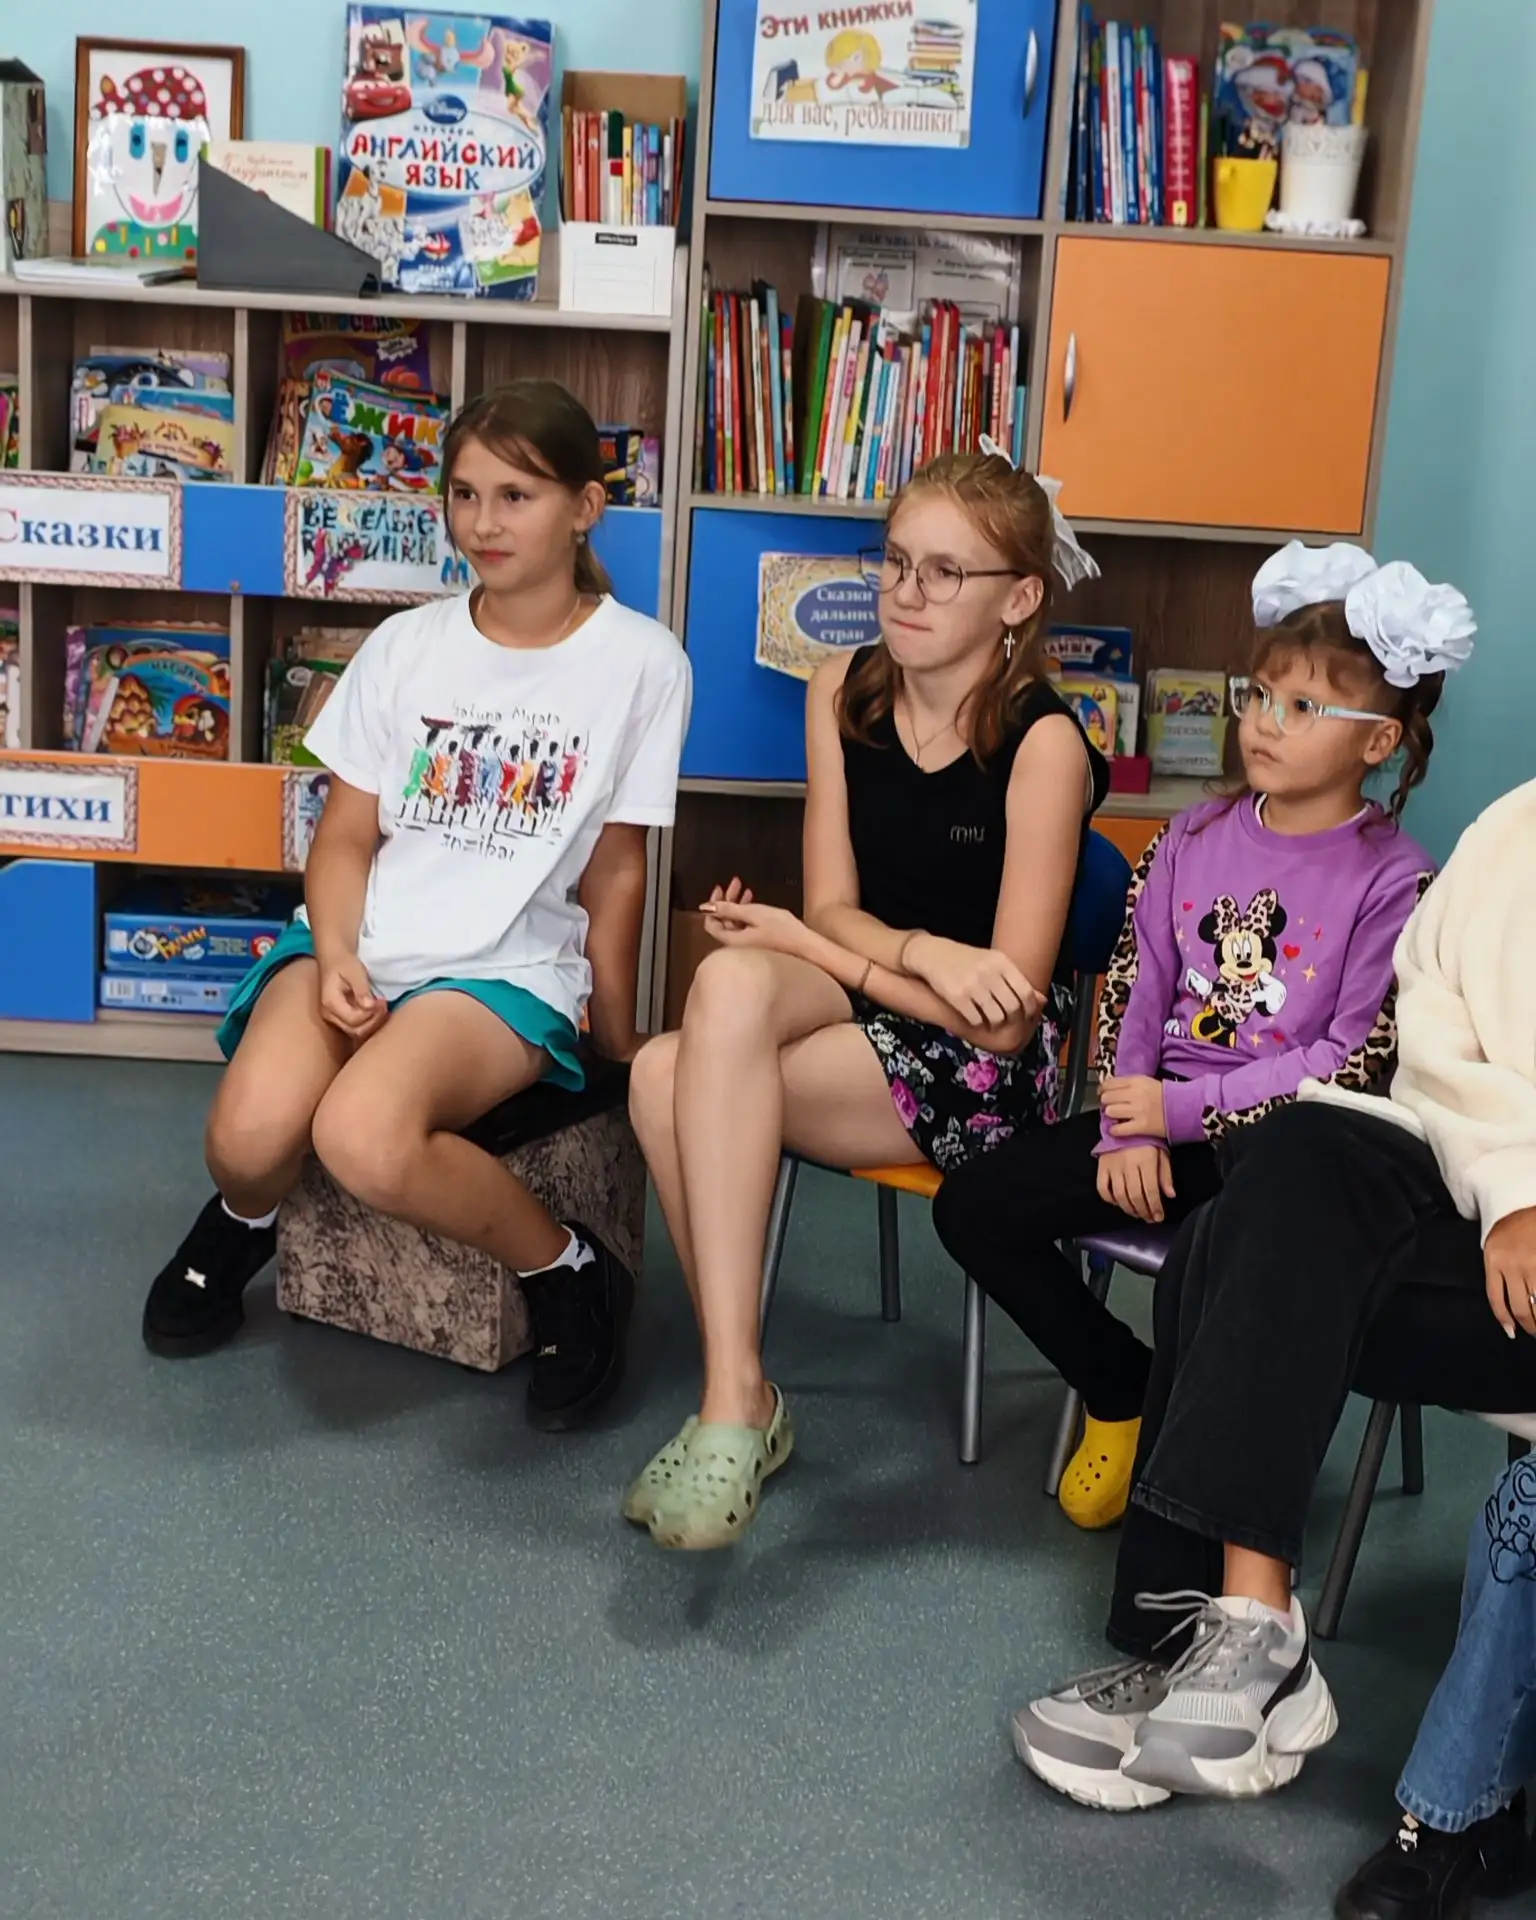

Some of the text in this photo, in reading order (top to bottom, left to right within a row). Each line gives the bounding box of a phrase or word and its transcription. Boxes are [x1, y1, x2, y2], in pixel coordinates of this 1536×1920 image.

[761, 0, 914, 39] Эти книжки
[761, 103, 795, 128] для
[802, 103, 838, 131] вас,
[351, 133, 536, 171] АНГЛИЙСКИЙ
[406, 163, 480, 190] ЯЗЫК
[0, 508, 163, 552] Сказки
[816, 588, 873, 603] Сказки
[810, 609, 876, 623] дальних
[820, 629, 865, 644] стран
[0, 793, 112, 823] тихи
